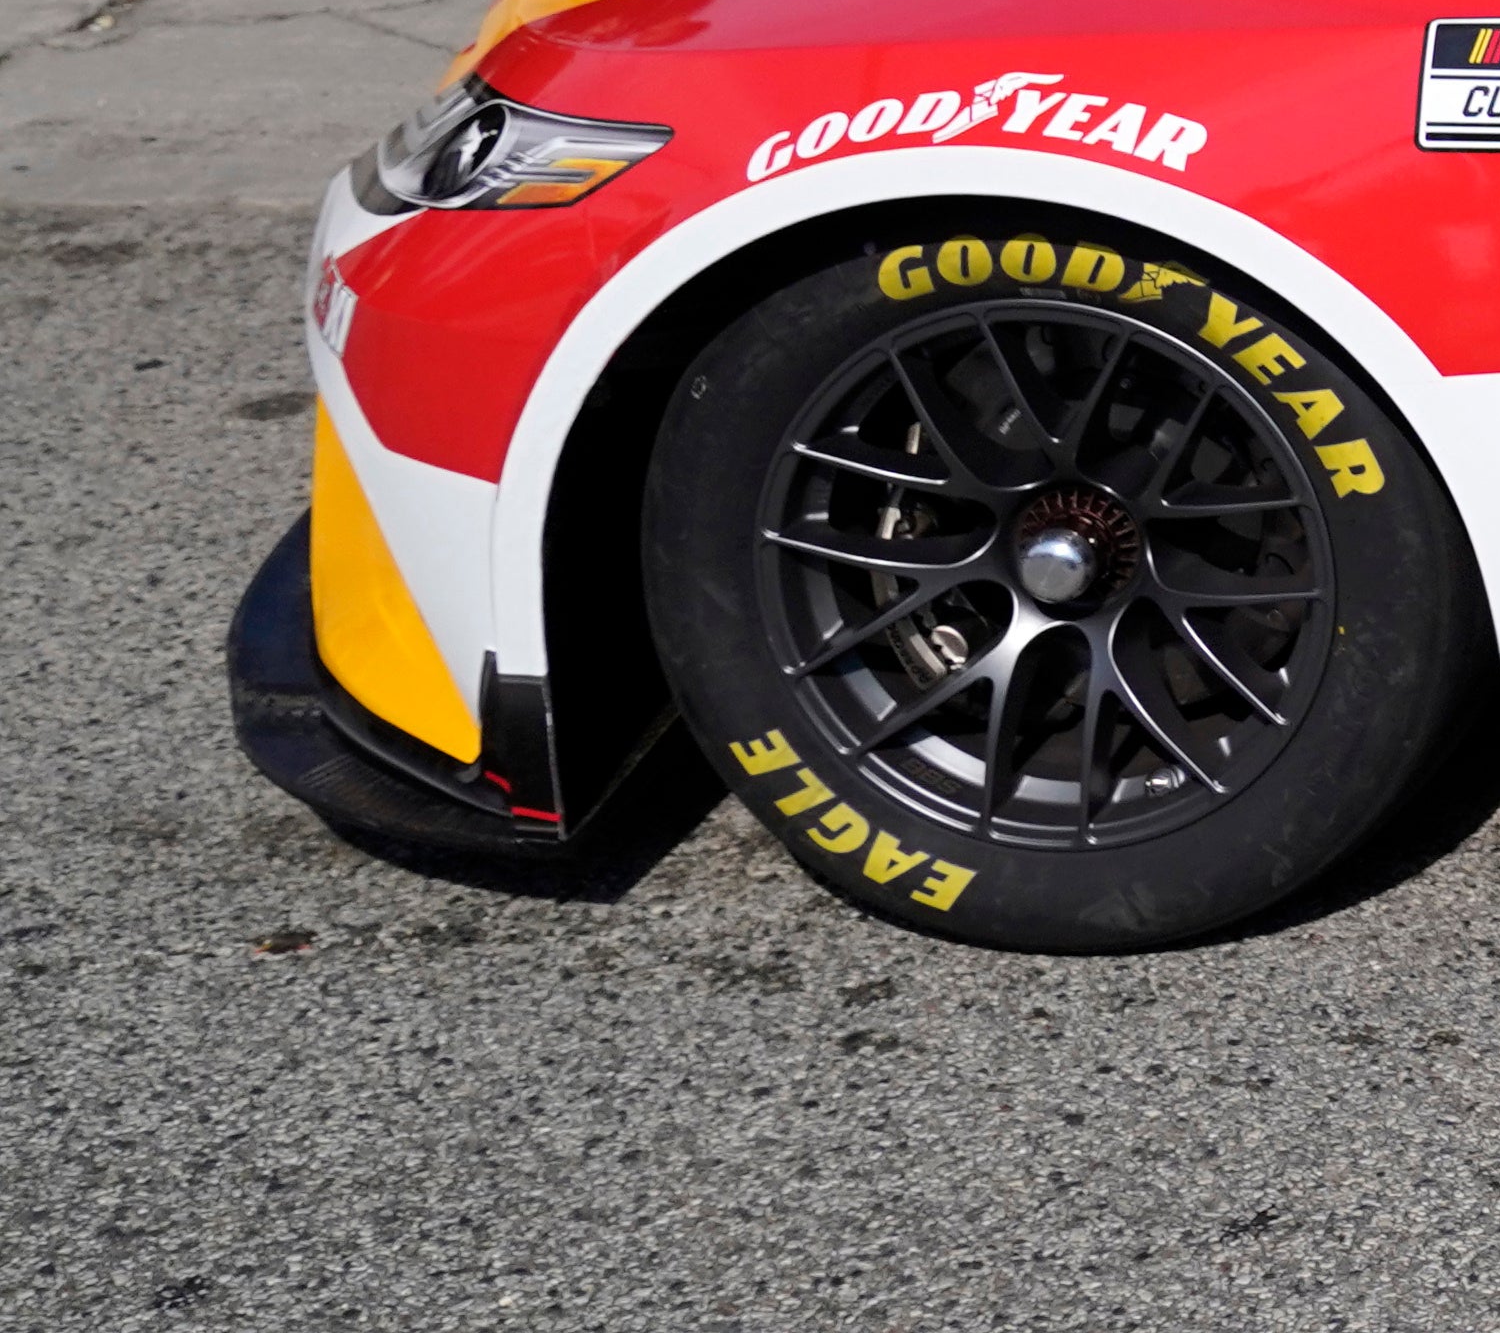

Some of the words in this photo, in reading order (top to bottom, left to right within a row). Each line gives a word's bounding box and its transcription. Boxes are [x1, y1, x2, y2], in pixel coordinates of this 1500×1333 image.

[747, 69, 1210, 185] GOODYEAR
[877, 233, 1386, 501] GOODYEAR
[728, 728, 979, 913] EAGLE
